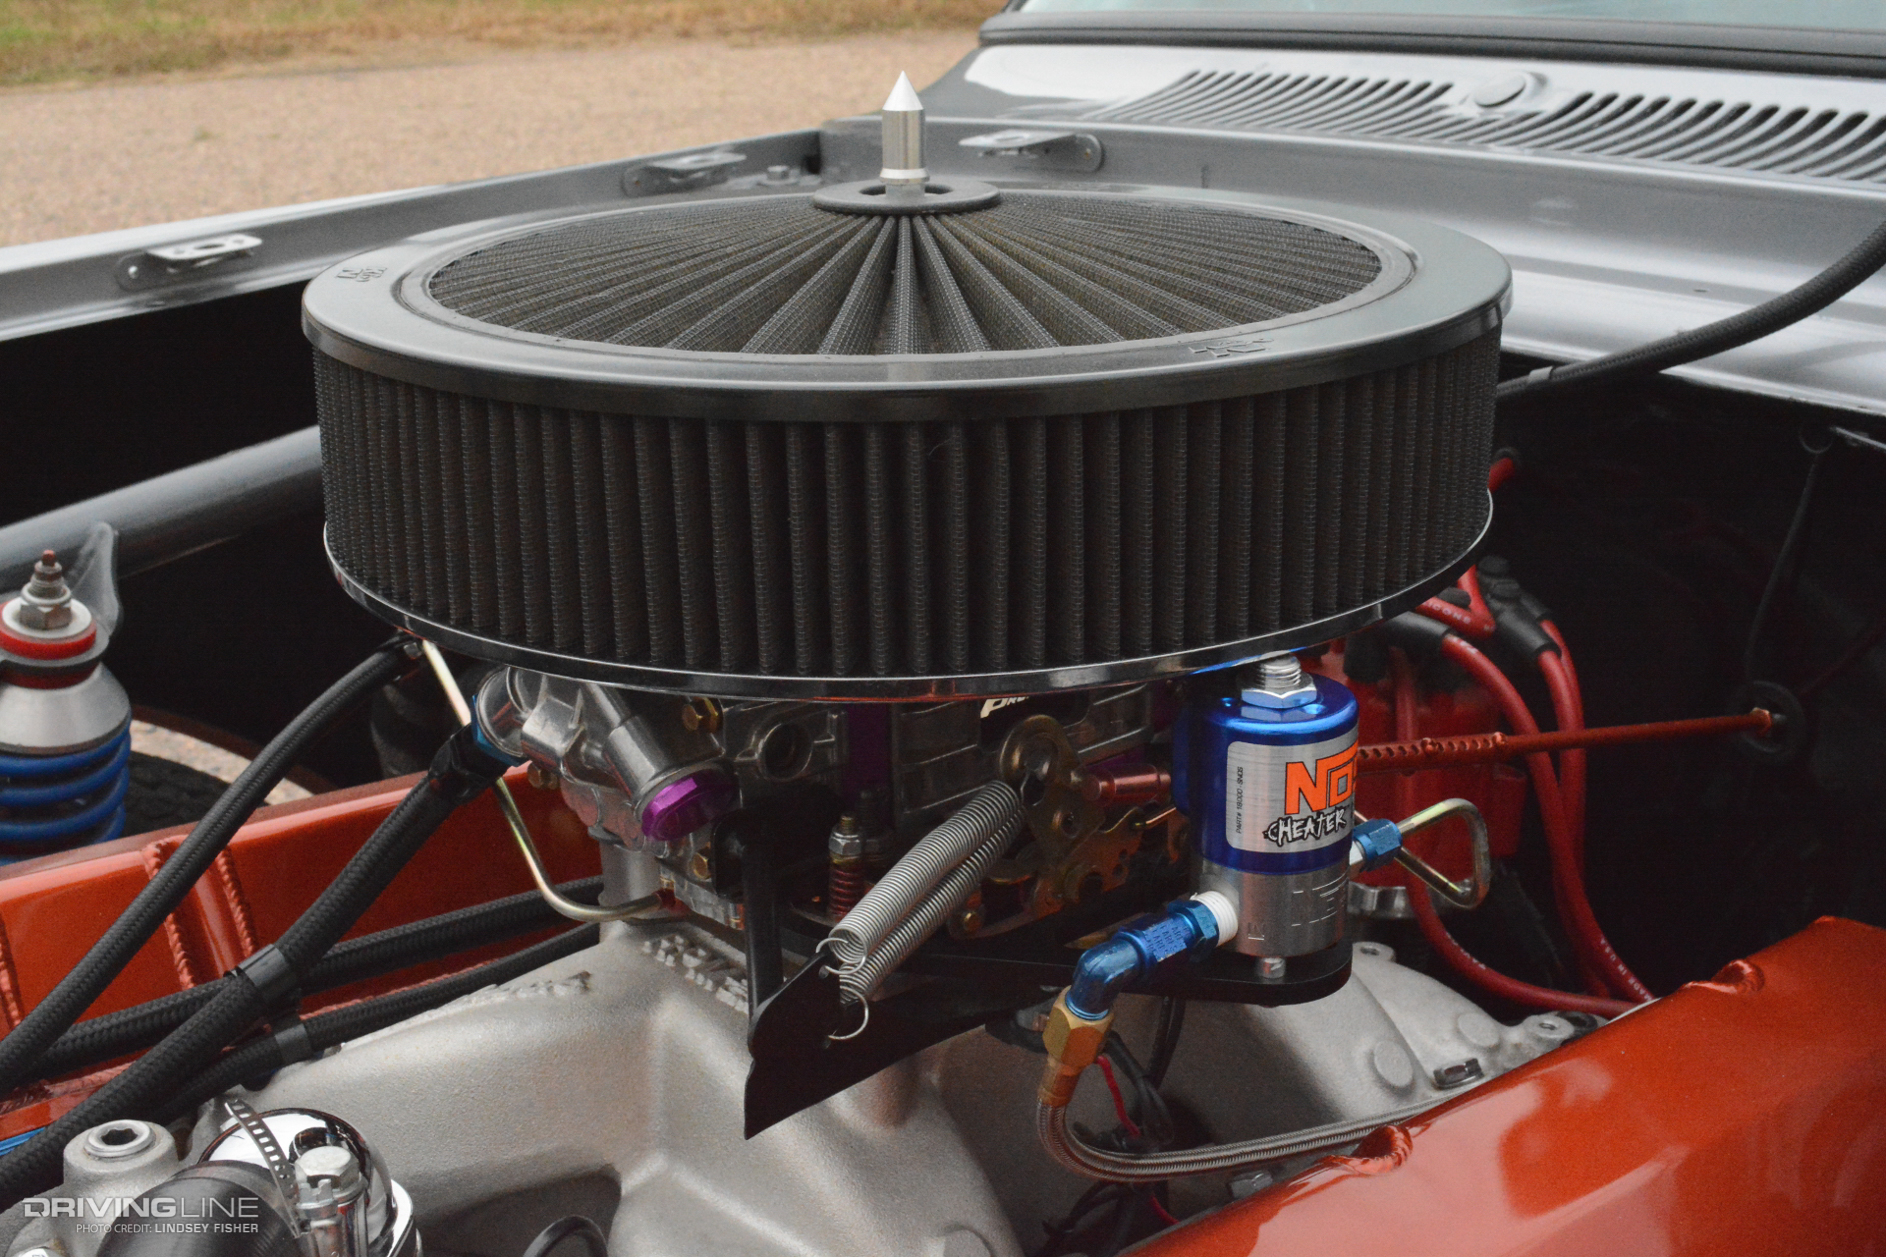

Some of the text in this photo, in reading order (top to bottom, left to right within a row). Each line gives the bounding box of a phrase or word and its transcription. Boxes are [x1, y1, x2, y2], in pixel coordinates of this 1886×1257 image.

[1284, 739, 1359, 815] NO
[1235, 812, 1243, 835] PART#
[1263, 806, 1348, 847] CHEATER
